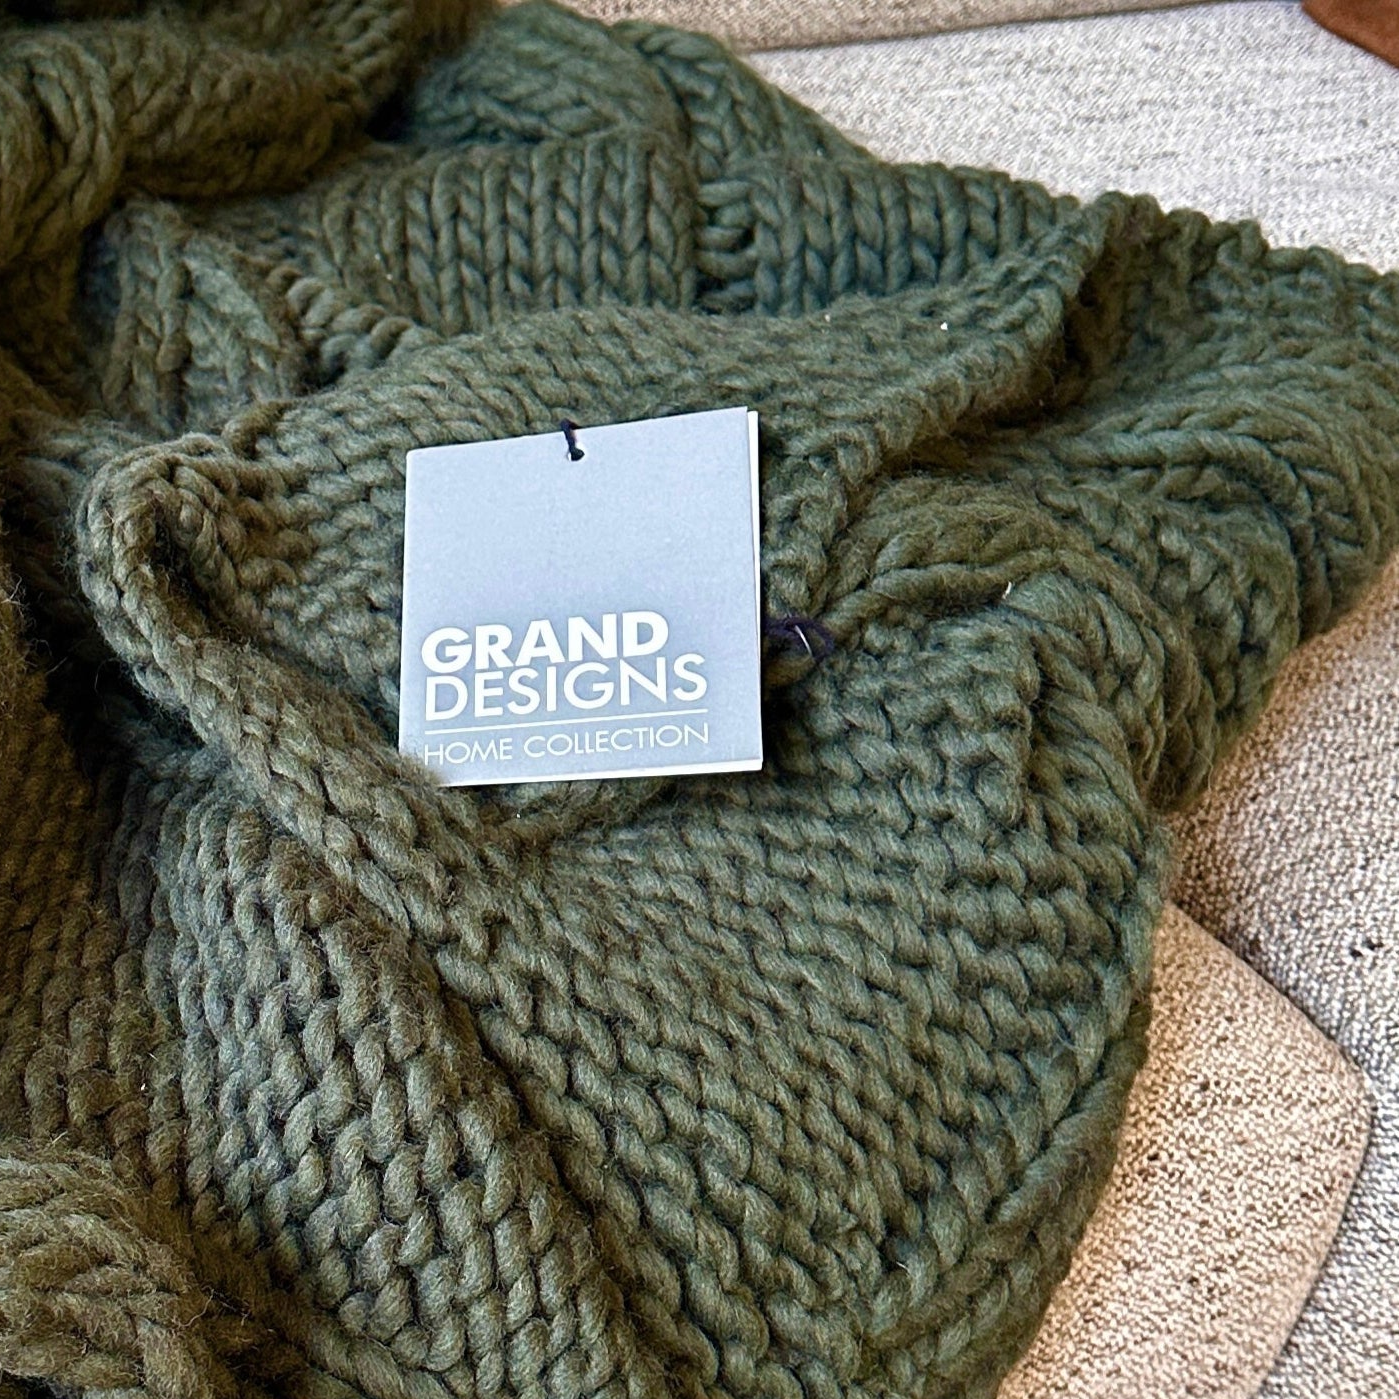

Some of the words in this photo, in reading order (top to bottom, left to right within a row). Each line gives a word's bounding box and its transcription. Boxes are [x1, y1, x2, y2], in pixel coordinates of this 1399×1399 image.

[421, 610, 669, 674] GRAND
[424, 653, 708, 721] DESIGNS
[424, 737, 513, 766] HOME
[523, 722, 709, 758] COLLECTION
